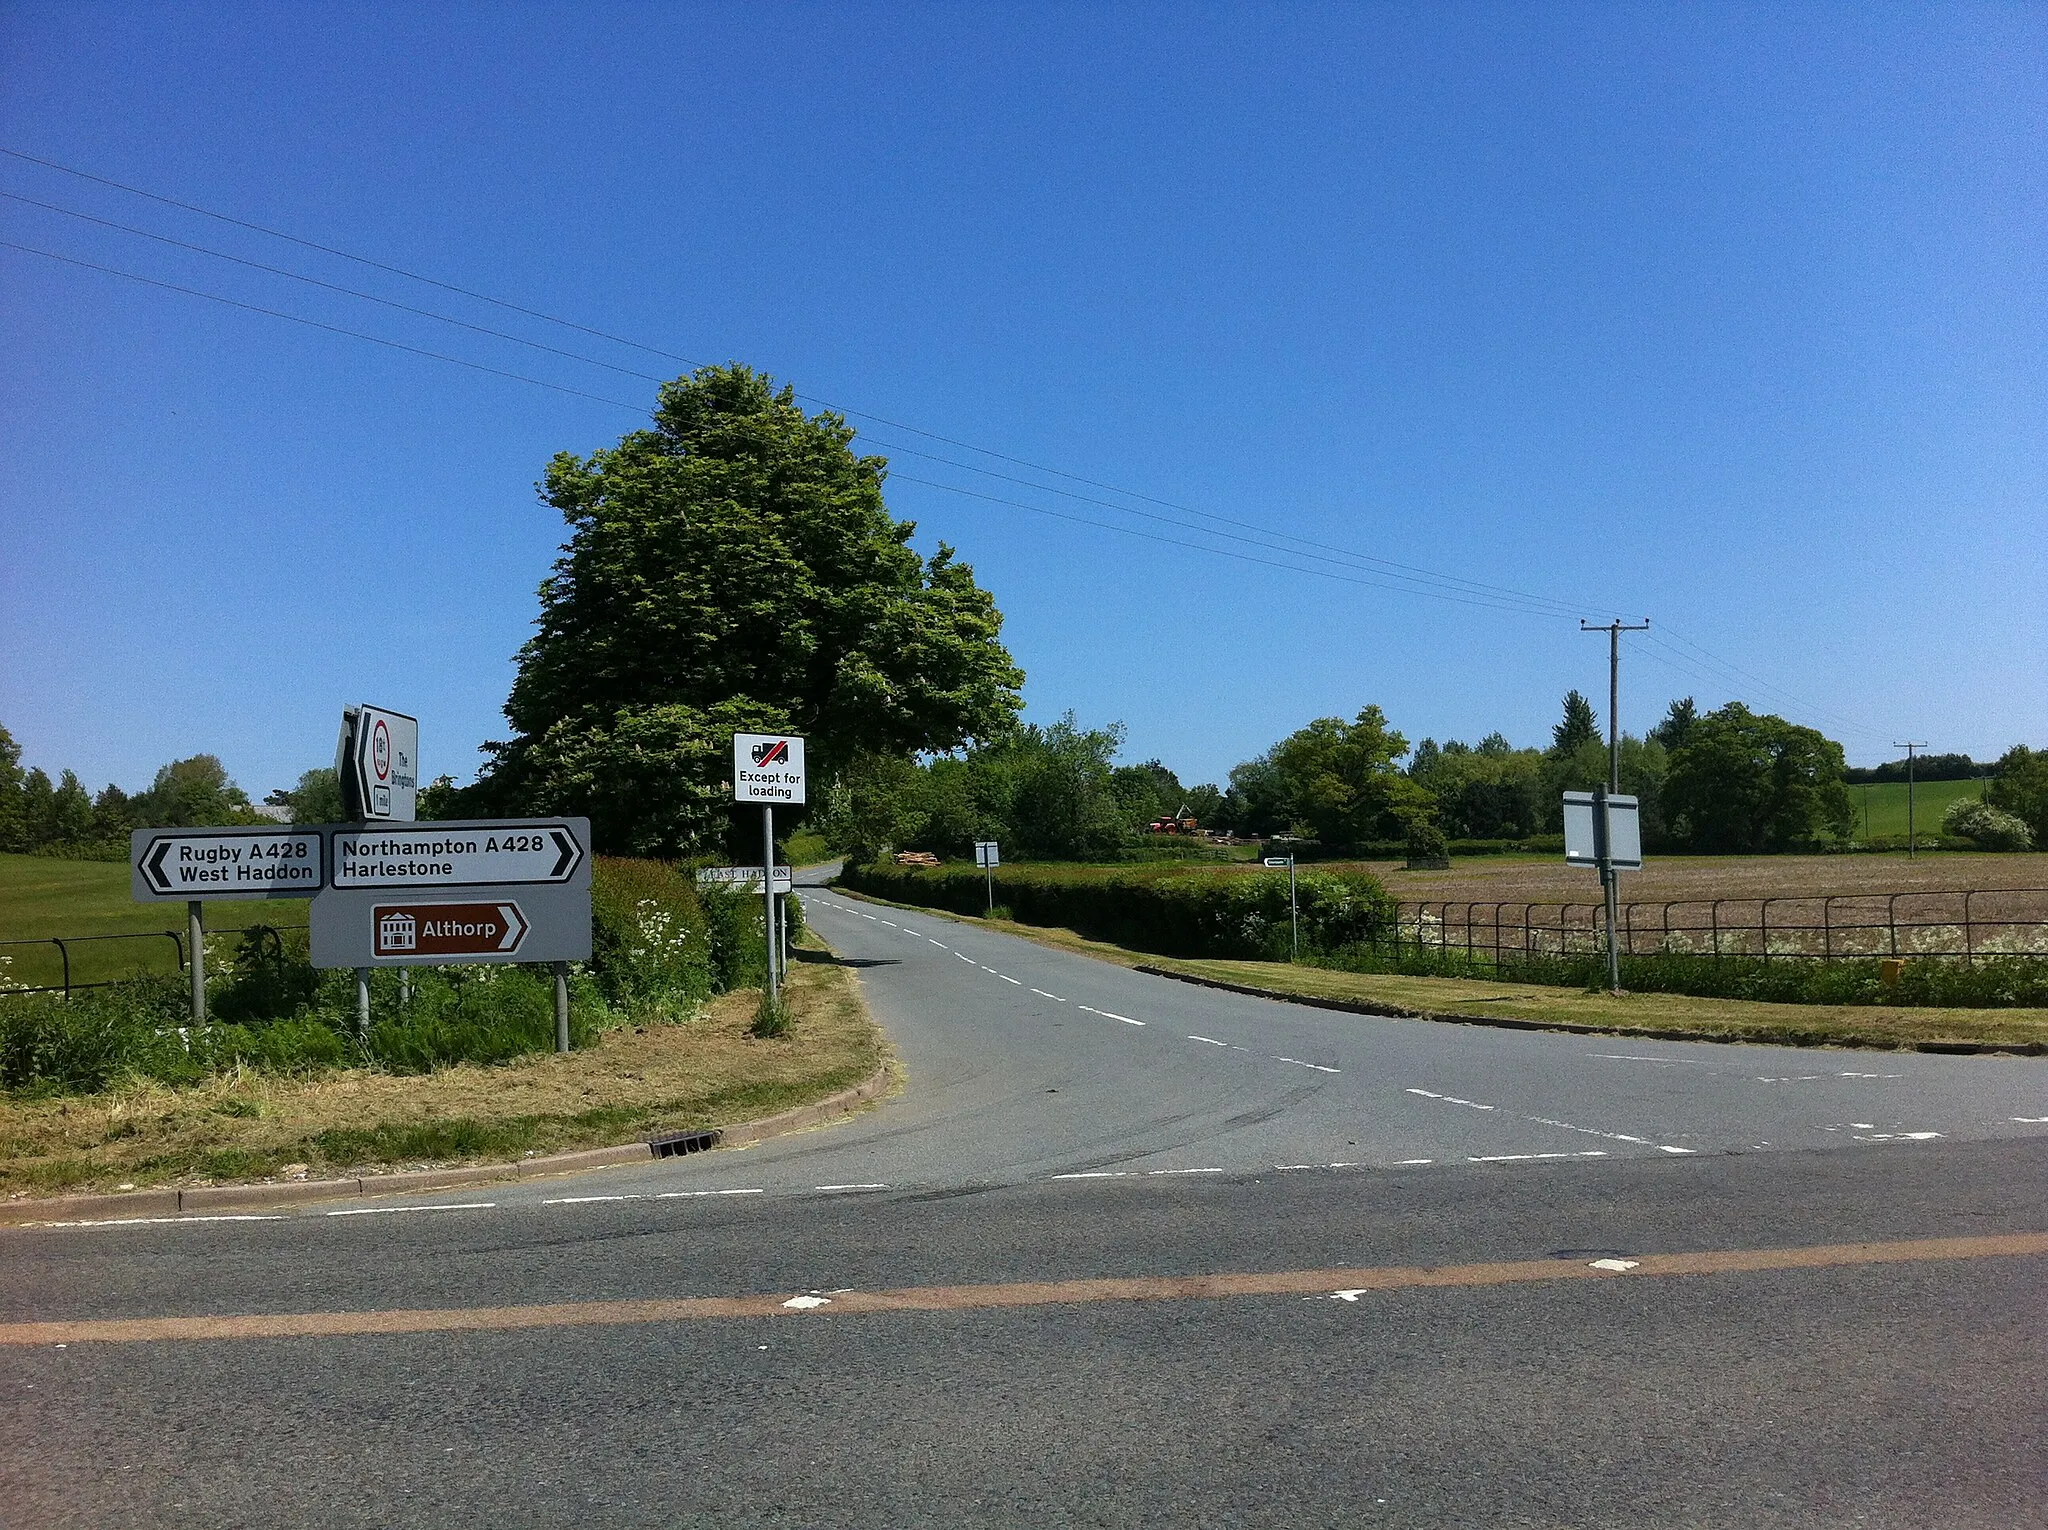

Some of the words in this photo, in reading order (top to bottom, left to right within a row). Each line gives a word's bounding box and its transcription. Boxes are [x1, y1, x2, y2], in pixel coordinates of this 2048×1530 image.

[398, 752, 408, 767] The
[391, 770, 414, 789] Bringtons
[740, 770, 780, 784] Except
[784, 773, 801, 784] for
[749, 785, 792, 799] loading
[179, 844, 241, 864] Rugby
[249, 842, 308, 860] A428
[342, 837, 477, 859] Northampton
[484, 835, 544, 853] A428
[179, 864, 232, 882] West
[237, 862, 313, 881] Haddon
[343, 859, 453, 878] Harlestone
[742, 868, 788, 879] HADON
[422, 918, 496, 941] Althorp
